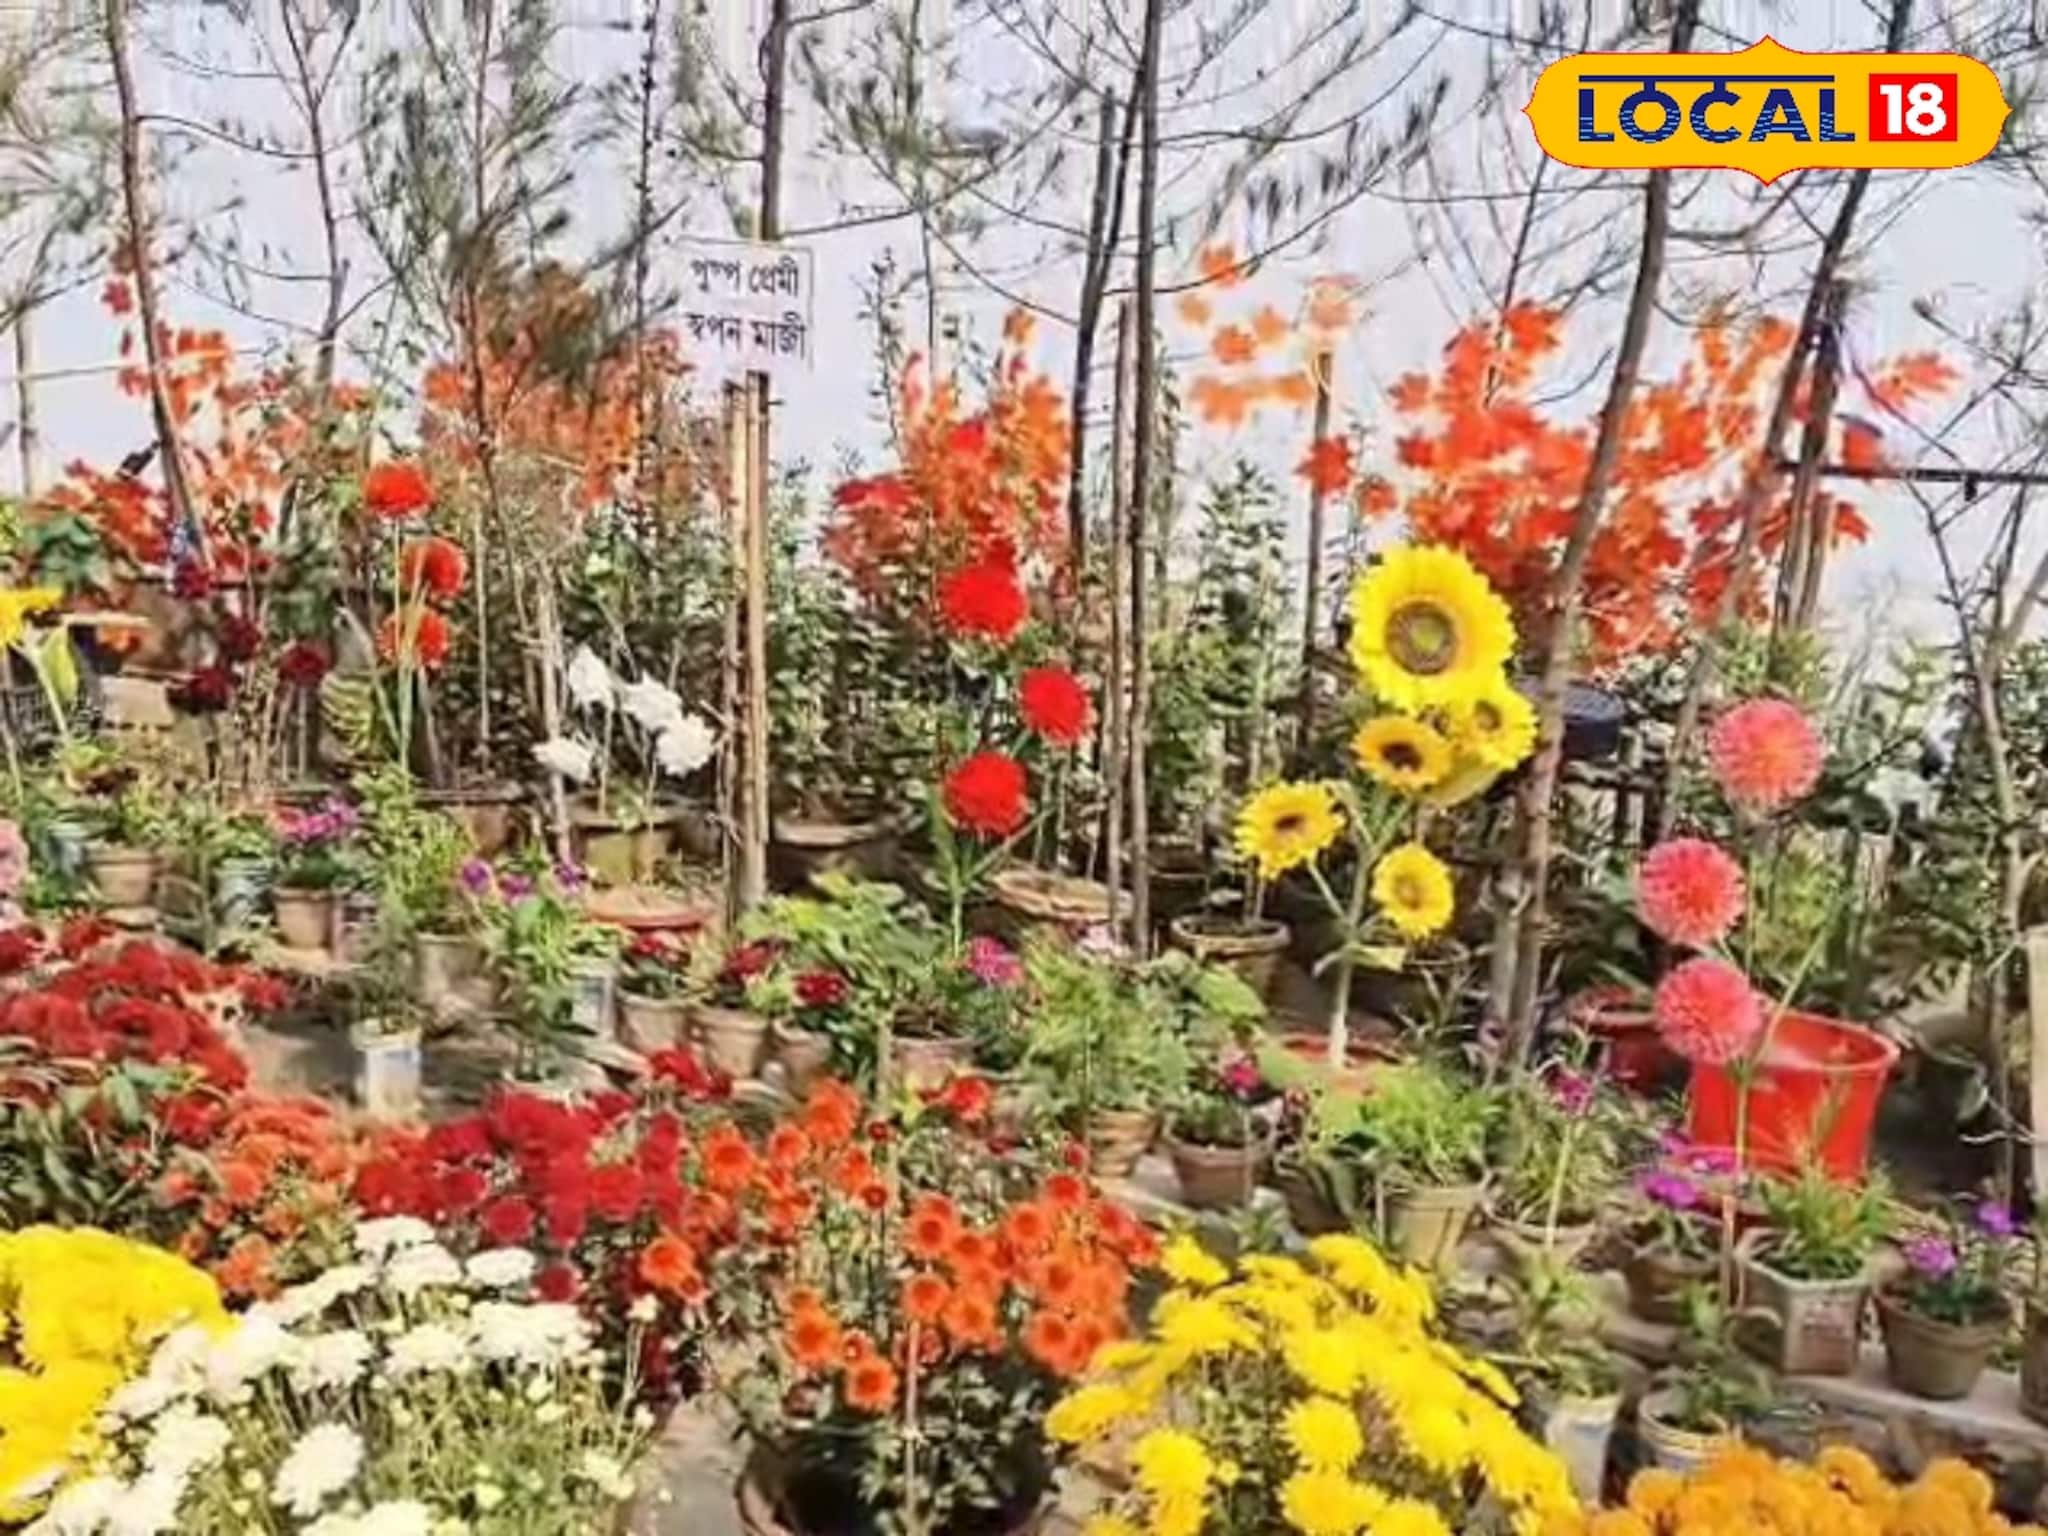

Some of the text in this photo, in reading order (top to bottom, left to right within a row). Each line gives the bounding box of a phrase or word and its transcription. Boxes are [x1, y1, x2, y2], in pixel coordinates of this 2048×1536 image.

[690, 255, 798, 298] পুষ্প প্রেমী
[687, 313, 741, 352] স্বপন
